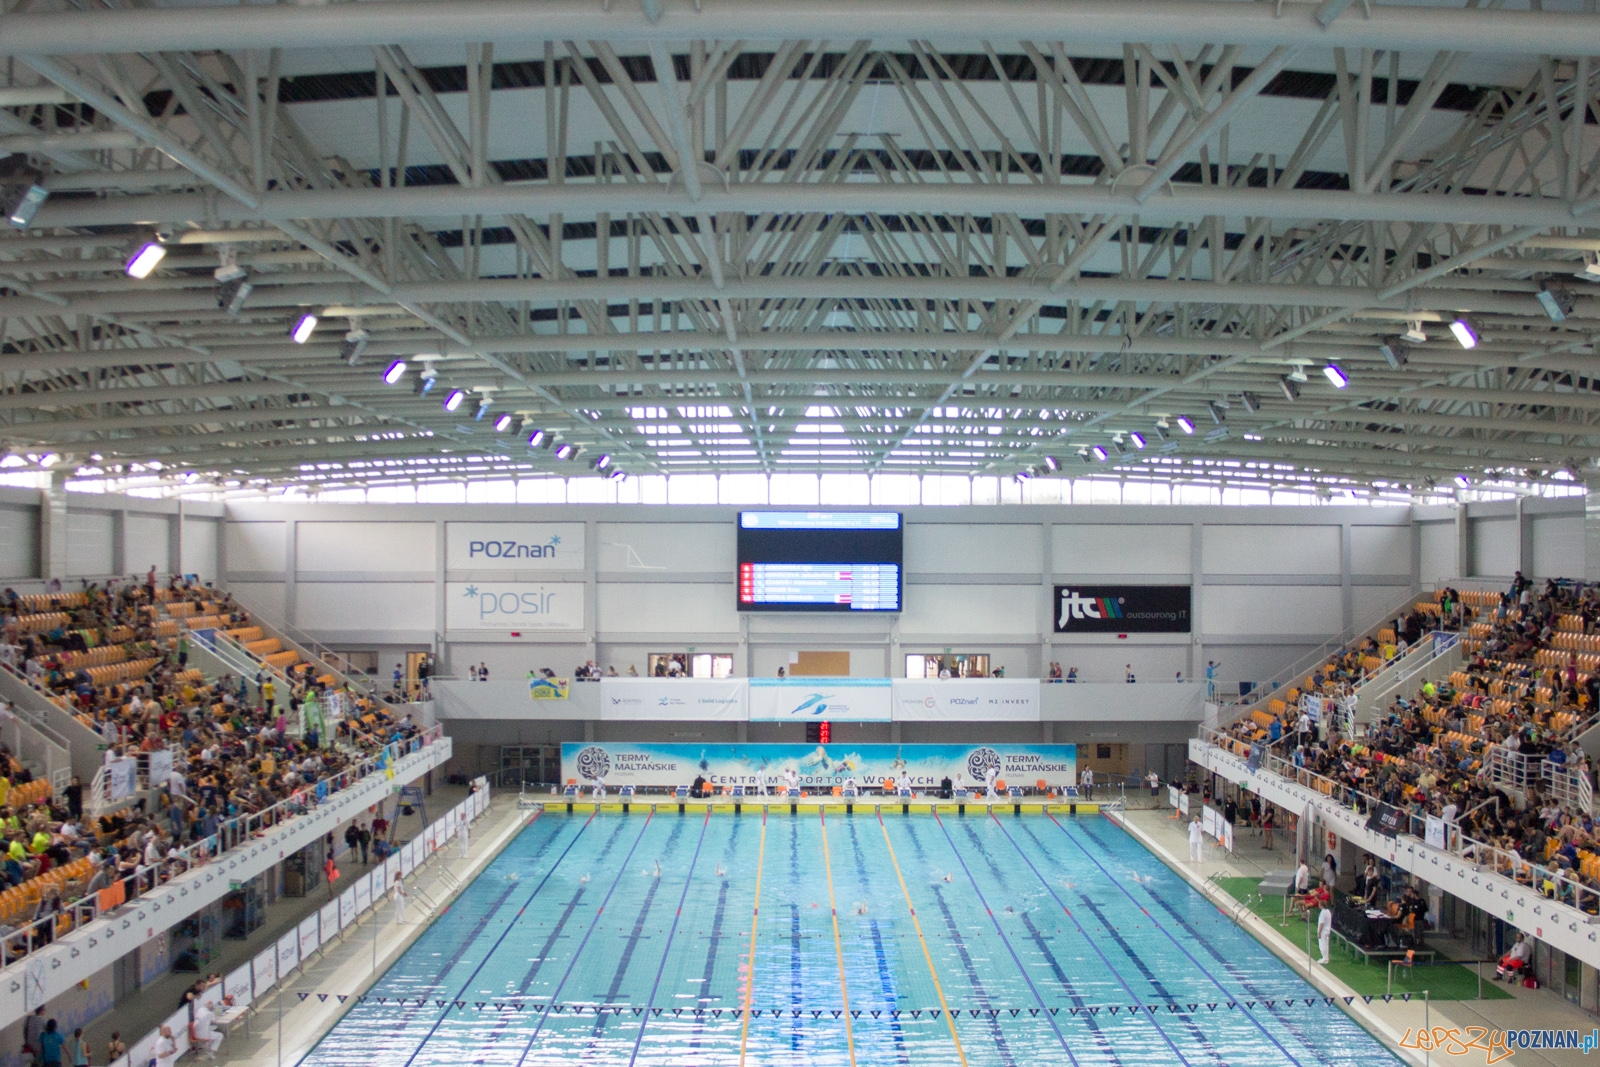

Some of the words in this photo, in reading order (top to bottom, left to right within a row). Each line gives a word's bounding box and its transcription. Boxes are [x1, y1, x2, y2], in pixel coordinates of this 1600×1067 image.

[480, 587, 556, 619] posir
[1179, 610, 1187, 618] IT
[615, 754, 650, 762] TERMY
[615, 761, 677, 771] MALTAŃSKIE
[1005, 763, 1067, 772] MALTAŃSKIE
[710, 775, 778, 784] CENTRM
[863, 776, 934, 785] WODYCH
